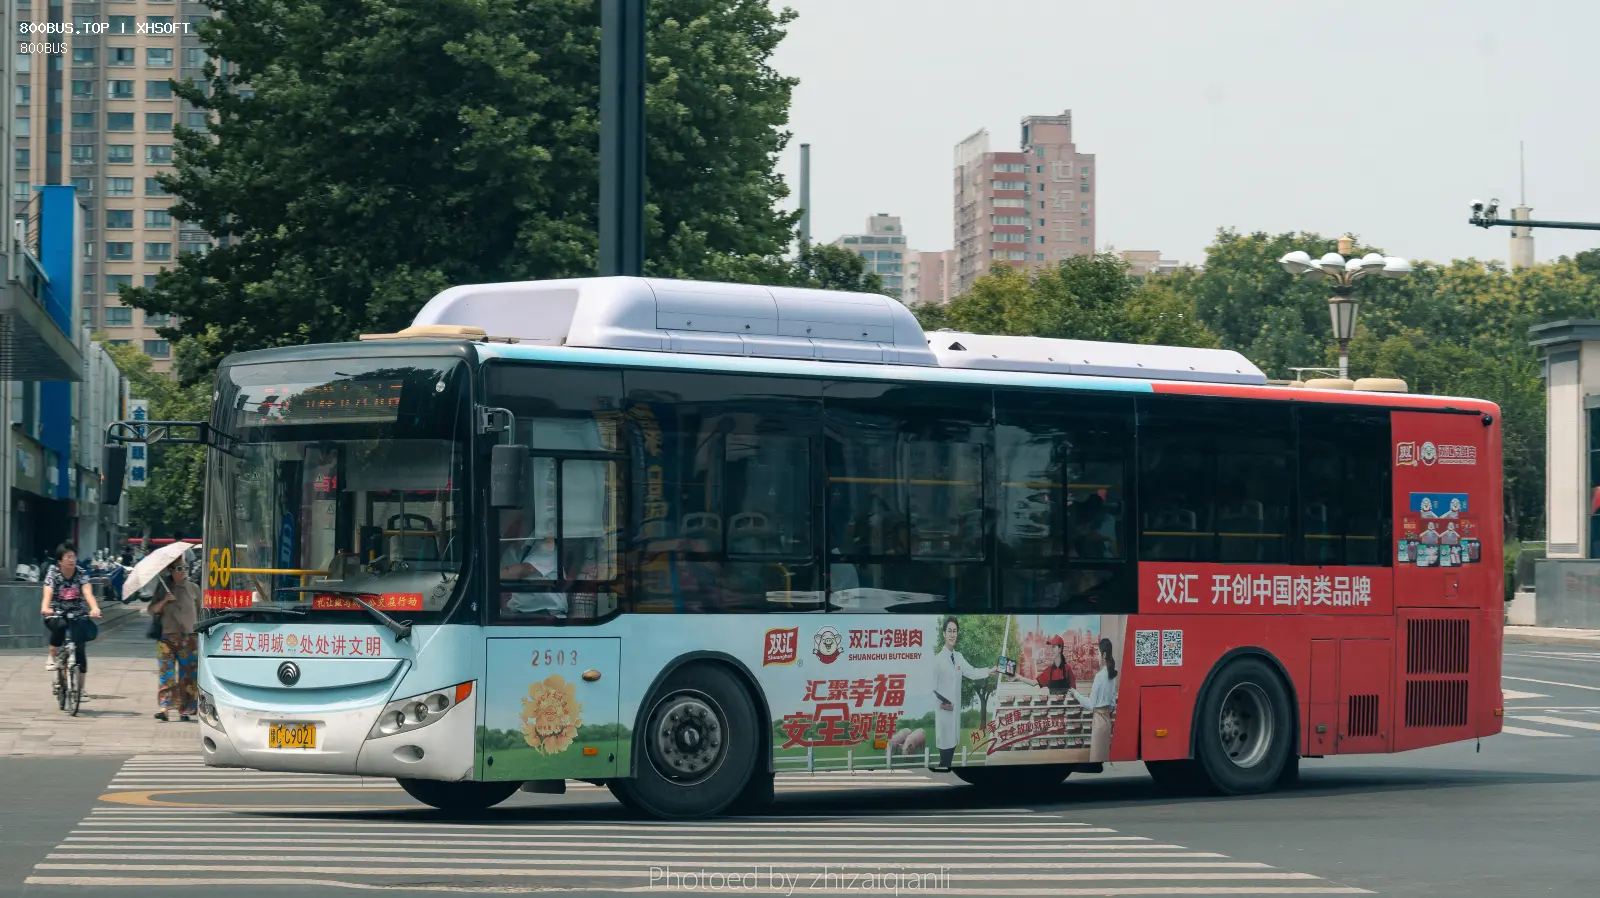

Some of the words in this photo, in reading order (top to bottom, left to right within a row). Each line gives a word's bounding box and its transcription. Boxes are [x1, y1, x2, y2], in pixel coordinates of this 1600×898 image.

[209, 548, 232, 587] 50
[1156, 573, 1199, 604] 双汇
[1211, 573, 1372, 607] 开创中国肉类品牌
[221, 631, 284, 654] 全国文明城
[299, 634, 381, 657] 处处讲文明
[767, 632, 794, 655] 双汇
[848, 628, 923, 649] 双汇冷鲜肉
[531, 649, 578, 666] 2503
[848, 653, 888, 661] SHUANGHUI
[888, 652, 922, 660] BUTCHERY
[801, 673, 907, 708] 汇聚幸福
